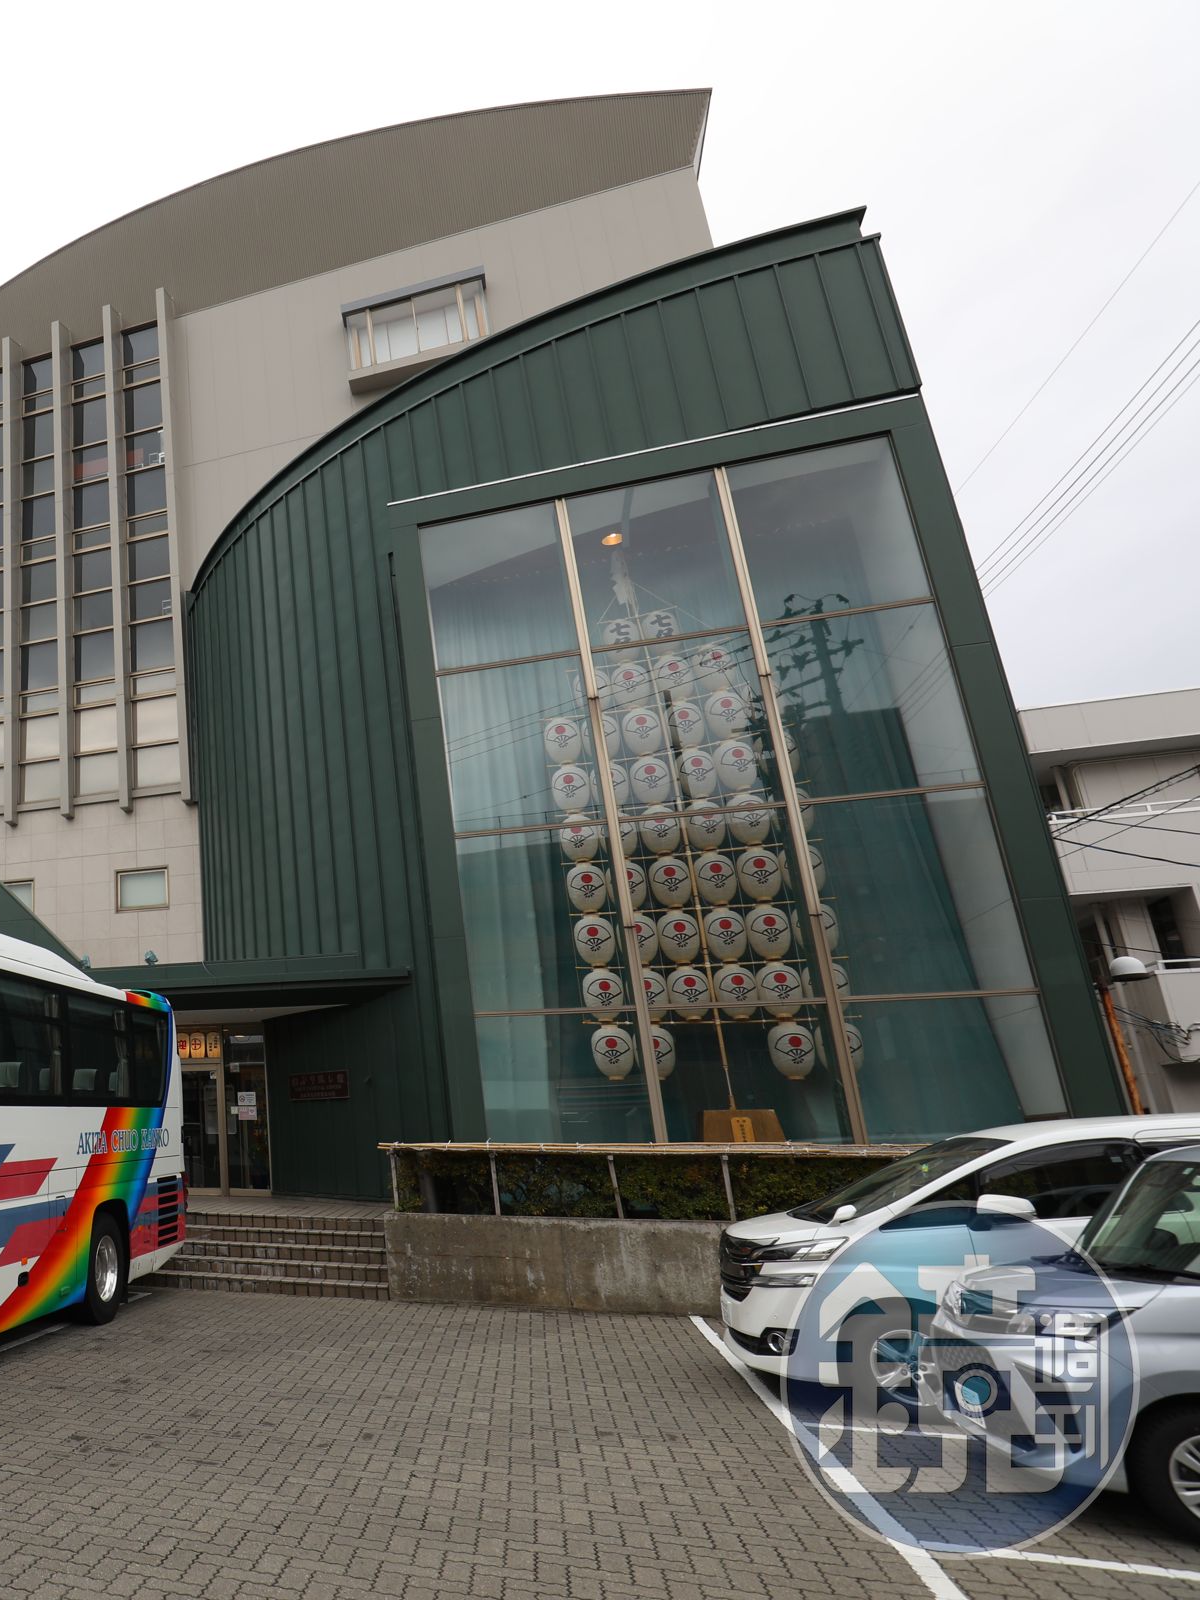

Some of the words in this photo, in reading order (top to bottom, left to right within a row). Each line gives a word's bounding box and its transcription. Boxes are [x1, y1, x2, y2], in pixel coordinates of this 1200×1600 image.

[76, 1130, 108, 1155] AKITA
[110, 1128, 139, 1153] CHUO
[140, 1127, 170, 1151] KANKO
